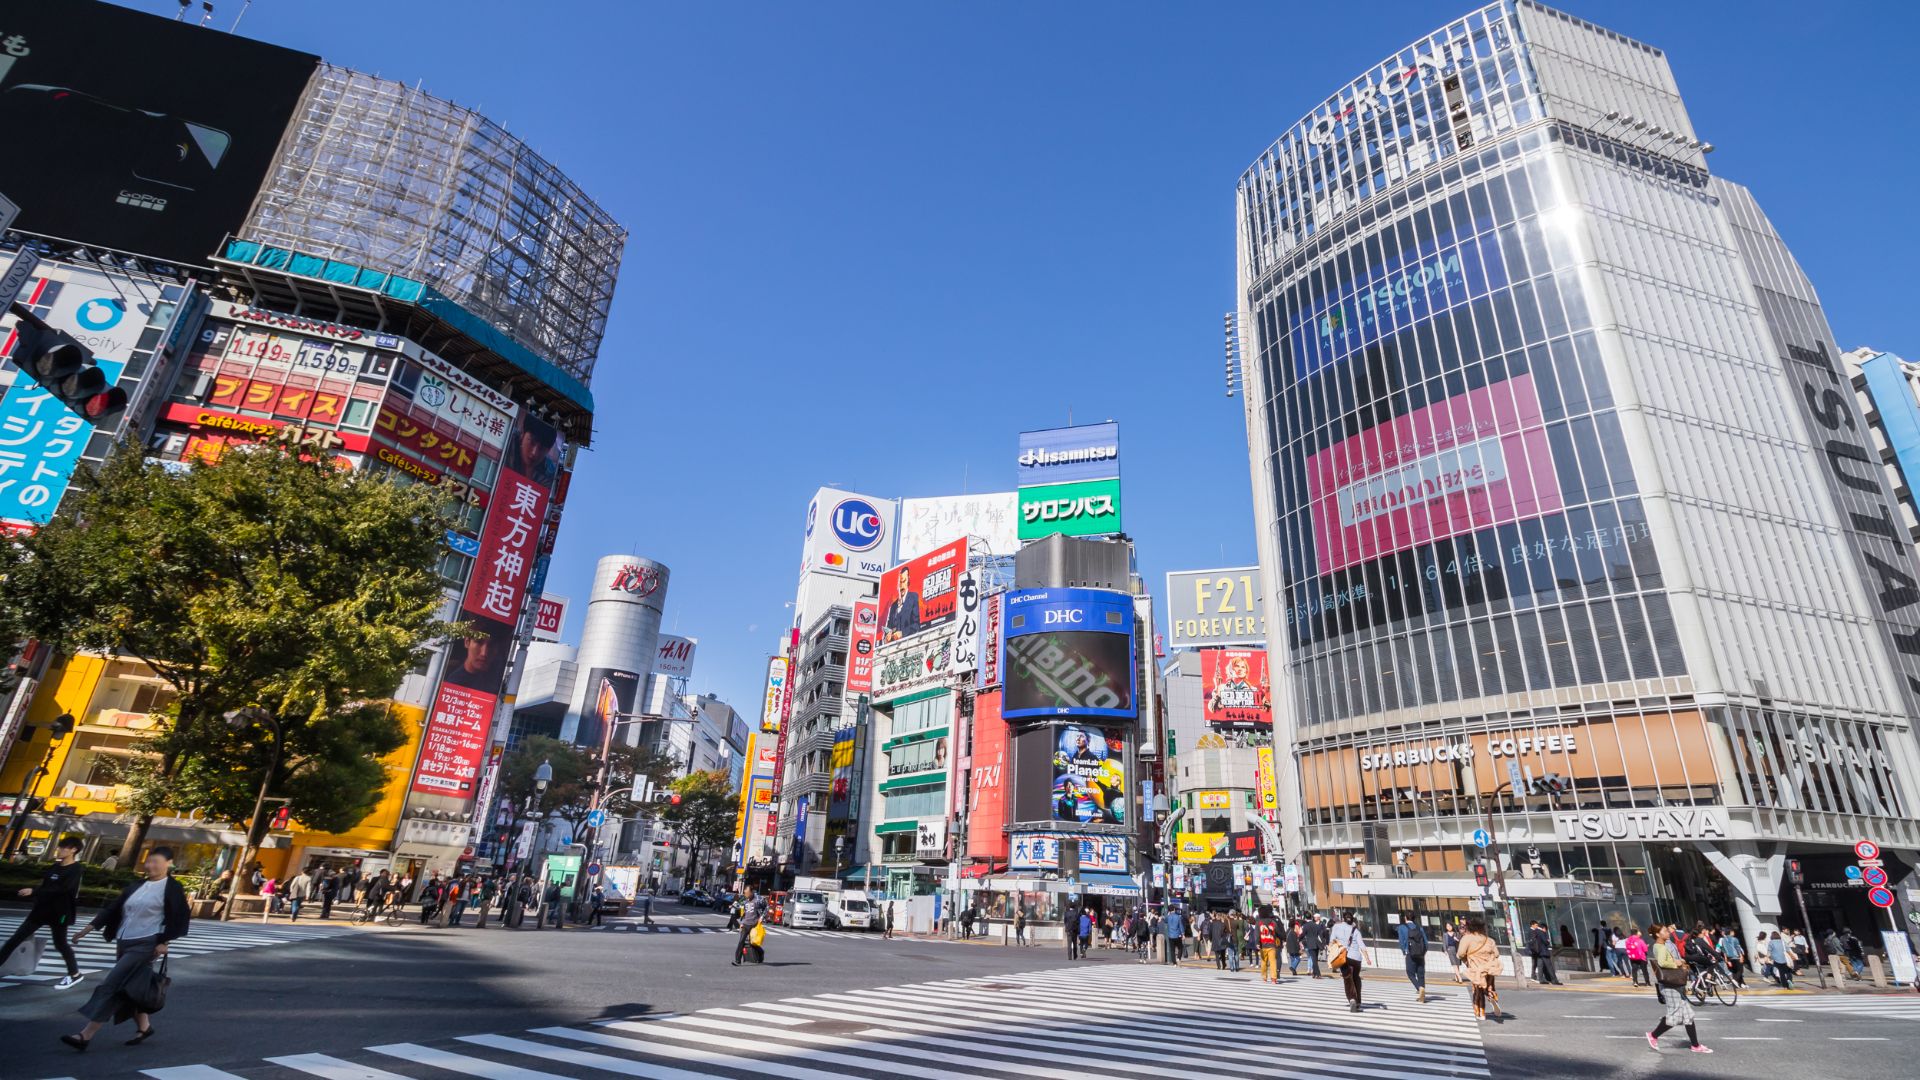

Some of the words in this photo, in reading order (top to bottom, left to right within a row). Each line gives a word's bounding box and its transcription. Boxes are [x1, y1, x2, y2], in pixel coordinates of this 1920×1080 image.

[119, 189, 168, 205] GoPro
[1354, 254, 1461, 312] TSCOM
[201, 329, 228, 345] 9F
[450, 394, 506, 437] しゃぶ葉
[377, 408, 472, 467] コンタクト
[18, 405, 84, 507] タクトの
[1018, 445, 1117, 466] Hisamitsu
[1021, 495, 1116, 523] サロンパス
[481, 481, 542, 618] 東方神起
[861, 562, 882, 573] VISA
[609, 569, 659, 598] 109
[1195, 575, 1255, 614] F21
[1010, 596, 1023, 605] DHC
[1023, 592, 1048, 602] Channel
[955, 572, 978, 668] もんじゃ
[1044, 609, 1083, 624] DHC
[1175, 616, 1257, 638] FOREVER
[658, 640, 692, 662] H&M
[435, 711, 481, 731] 東京ドーム
[1073, 758, 1099, 766] teamLab
[1362, 743, 1475, 771] STARBUCKS
[1487, 734, 1577, 758] COFFEE
[1785, 738, 1892, 772] TSUTAYA
[1067, 763, 1110, 777] Planets
[1559, 810, 1725, 839] TSUTAYA
